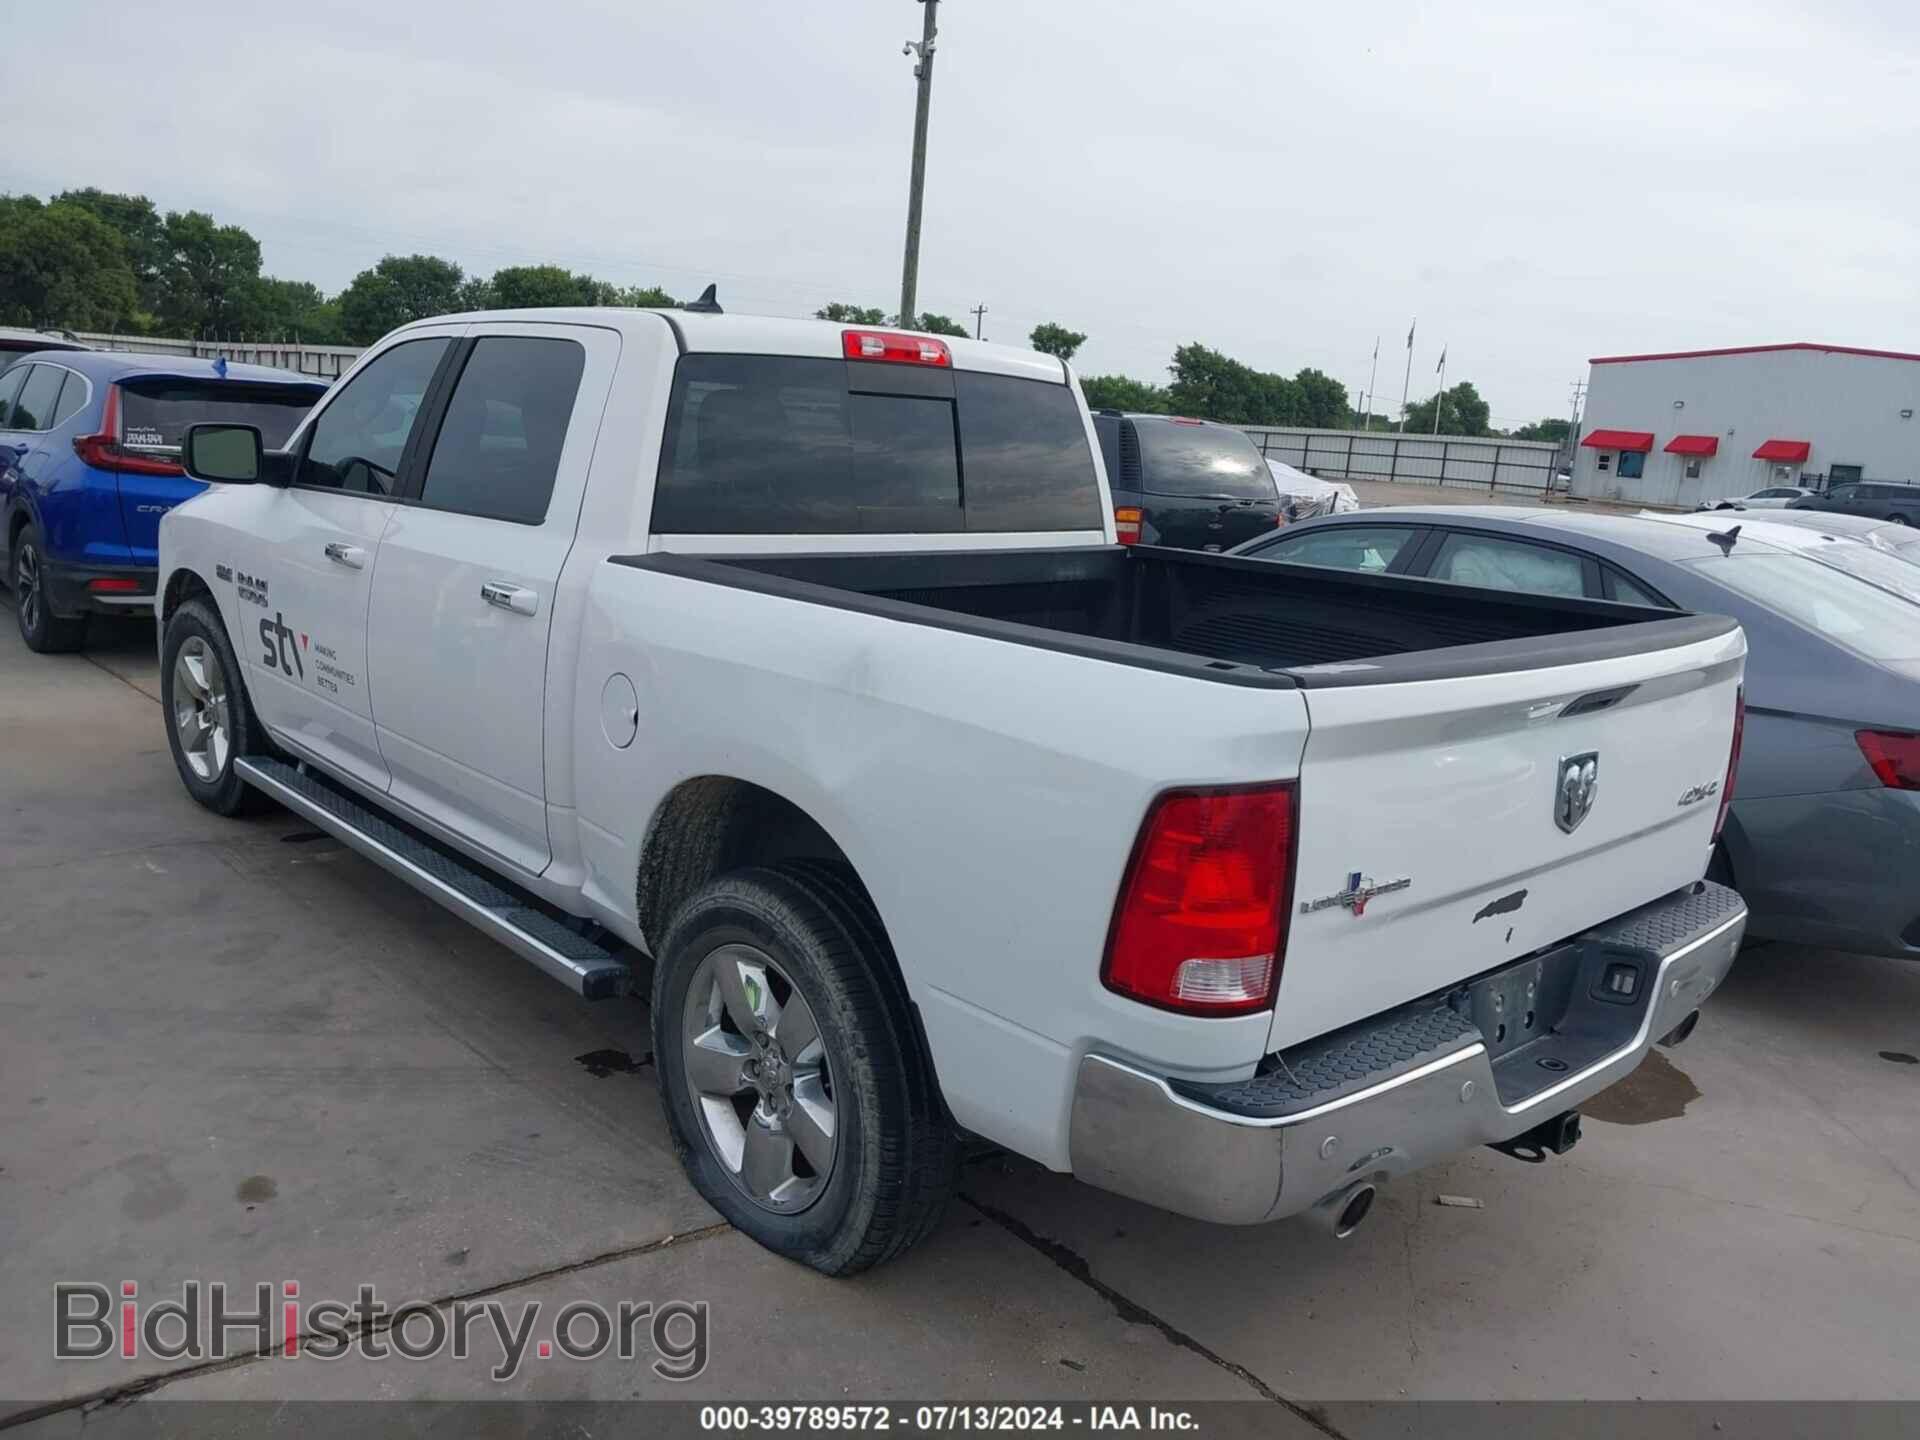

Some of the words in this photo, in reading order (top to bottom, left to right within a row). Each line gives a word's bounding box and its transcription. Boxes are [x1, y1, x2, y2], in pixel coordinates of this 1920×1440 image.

[314, 642, 337, 661] MAKING
[314, 659, 356, 687] COMMUNITIES
[316, 675, 338, 694] BETTER
